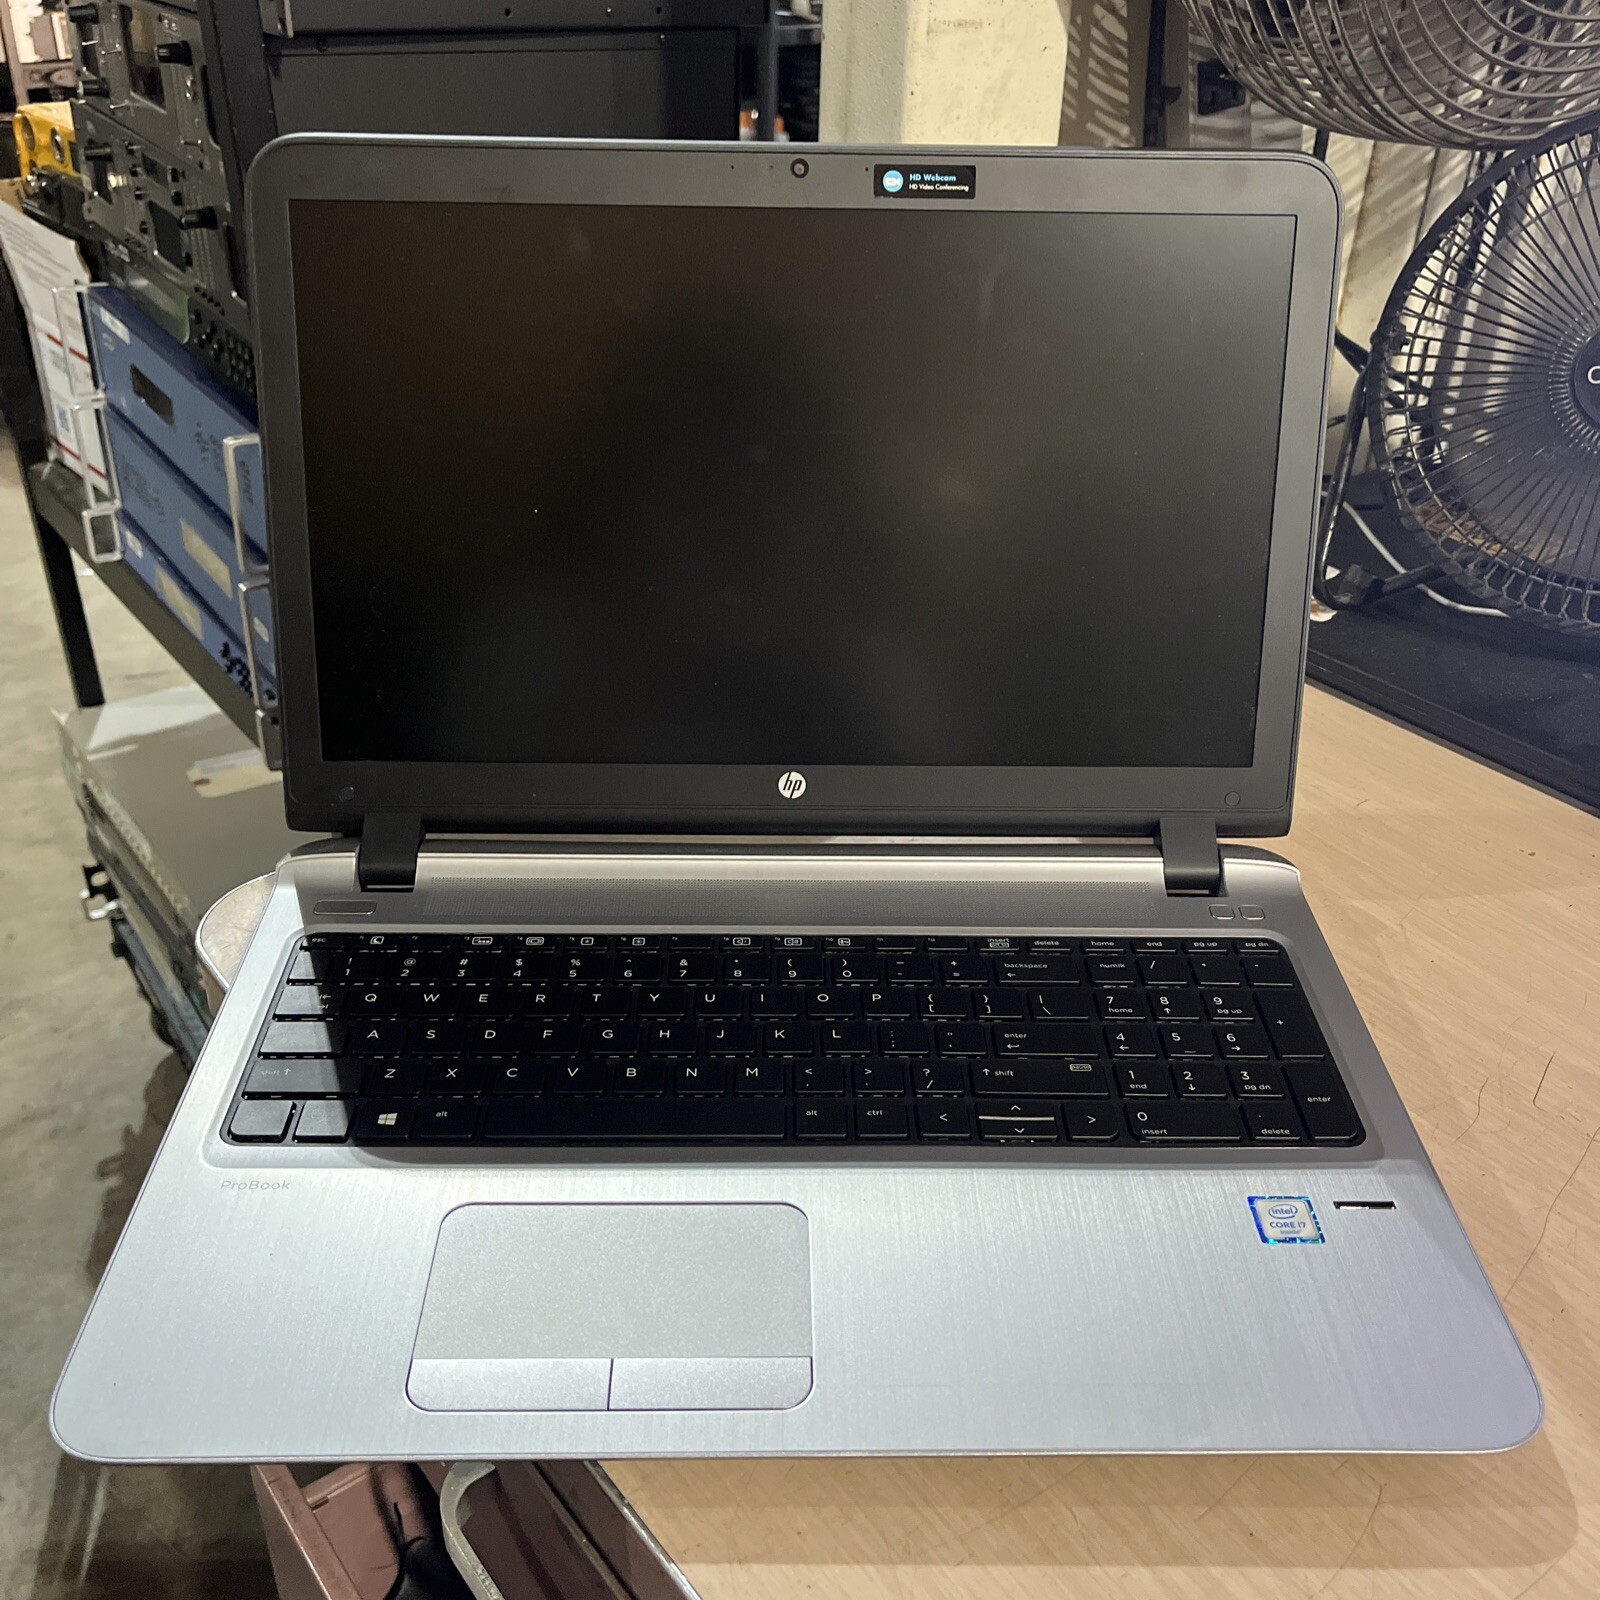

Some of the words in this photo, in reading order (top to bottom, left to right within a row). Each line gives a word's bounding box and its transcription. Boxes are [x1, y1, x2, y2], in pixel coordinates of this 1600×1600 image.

[909, 173, 921, 181] HD
[923, 173, 957, 182] Webcam
[935, 183, 969, 192] Conferencing
[424, 994, 439, 1002] W
[479, 994, 488, 1002] E
[705, 994, 715, 1002] U
[761, 994, 763, 1002] I
[817, 994, 828, 1002] O
[1107, 996, 1113, 1004] 7
[367, 1030, 378, 1038] A
[427, 1030, 435, 1038] S
[485, 1030, 496, 1038] D
[543, 1030, 552, 1038] F
[602, 1030, 613, 1038] G
[660, 1030, 669, 1038] H
[717, 1030, 724, 1038] J
[775, 1030, 784, 1038] K
[833, 1030, 841, 1038] L
[1172, 1033, 1180, 1041] 5
[385, 1069, 395, 1078] Z
[446, 1069, 457, 1077] X
[507, 1068, 517, 1077] C
[568, 1068, 578, 1076] V
[627, 1068, 636, 1076] B
[687, 1068, 697, 1076] N
[746, 1068, 758, 1076] M
[1129, 1071, 1134, 1079] 1
[1184, 1071, 1192, 1080] 2
[1241, 1071, 1249, 1080] 3
[1245, 1083, 1257, 1091] pg
[1142, 1127, 1168, 1135] insert
[1261, 1127, 1290, 1135] delete
[221, 1180, 291, 1190] ProBook
[1271, 1207, 1294, 1215] intel
[1270, 1221, 1296, 1229] CORE
